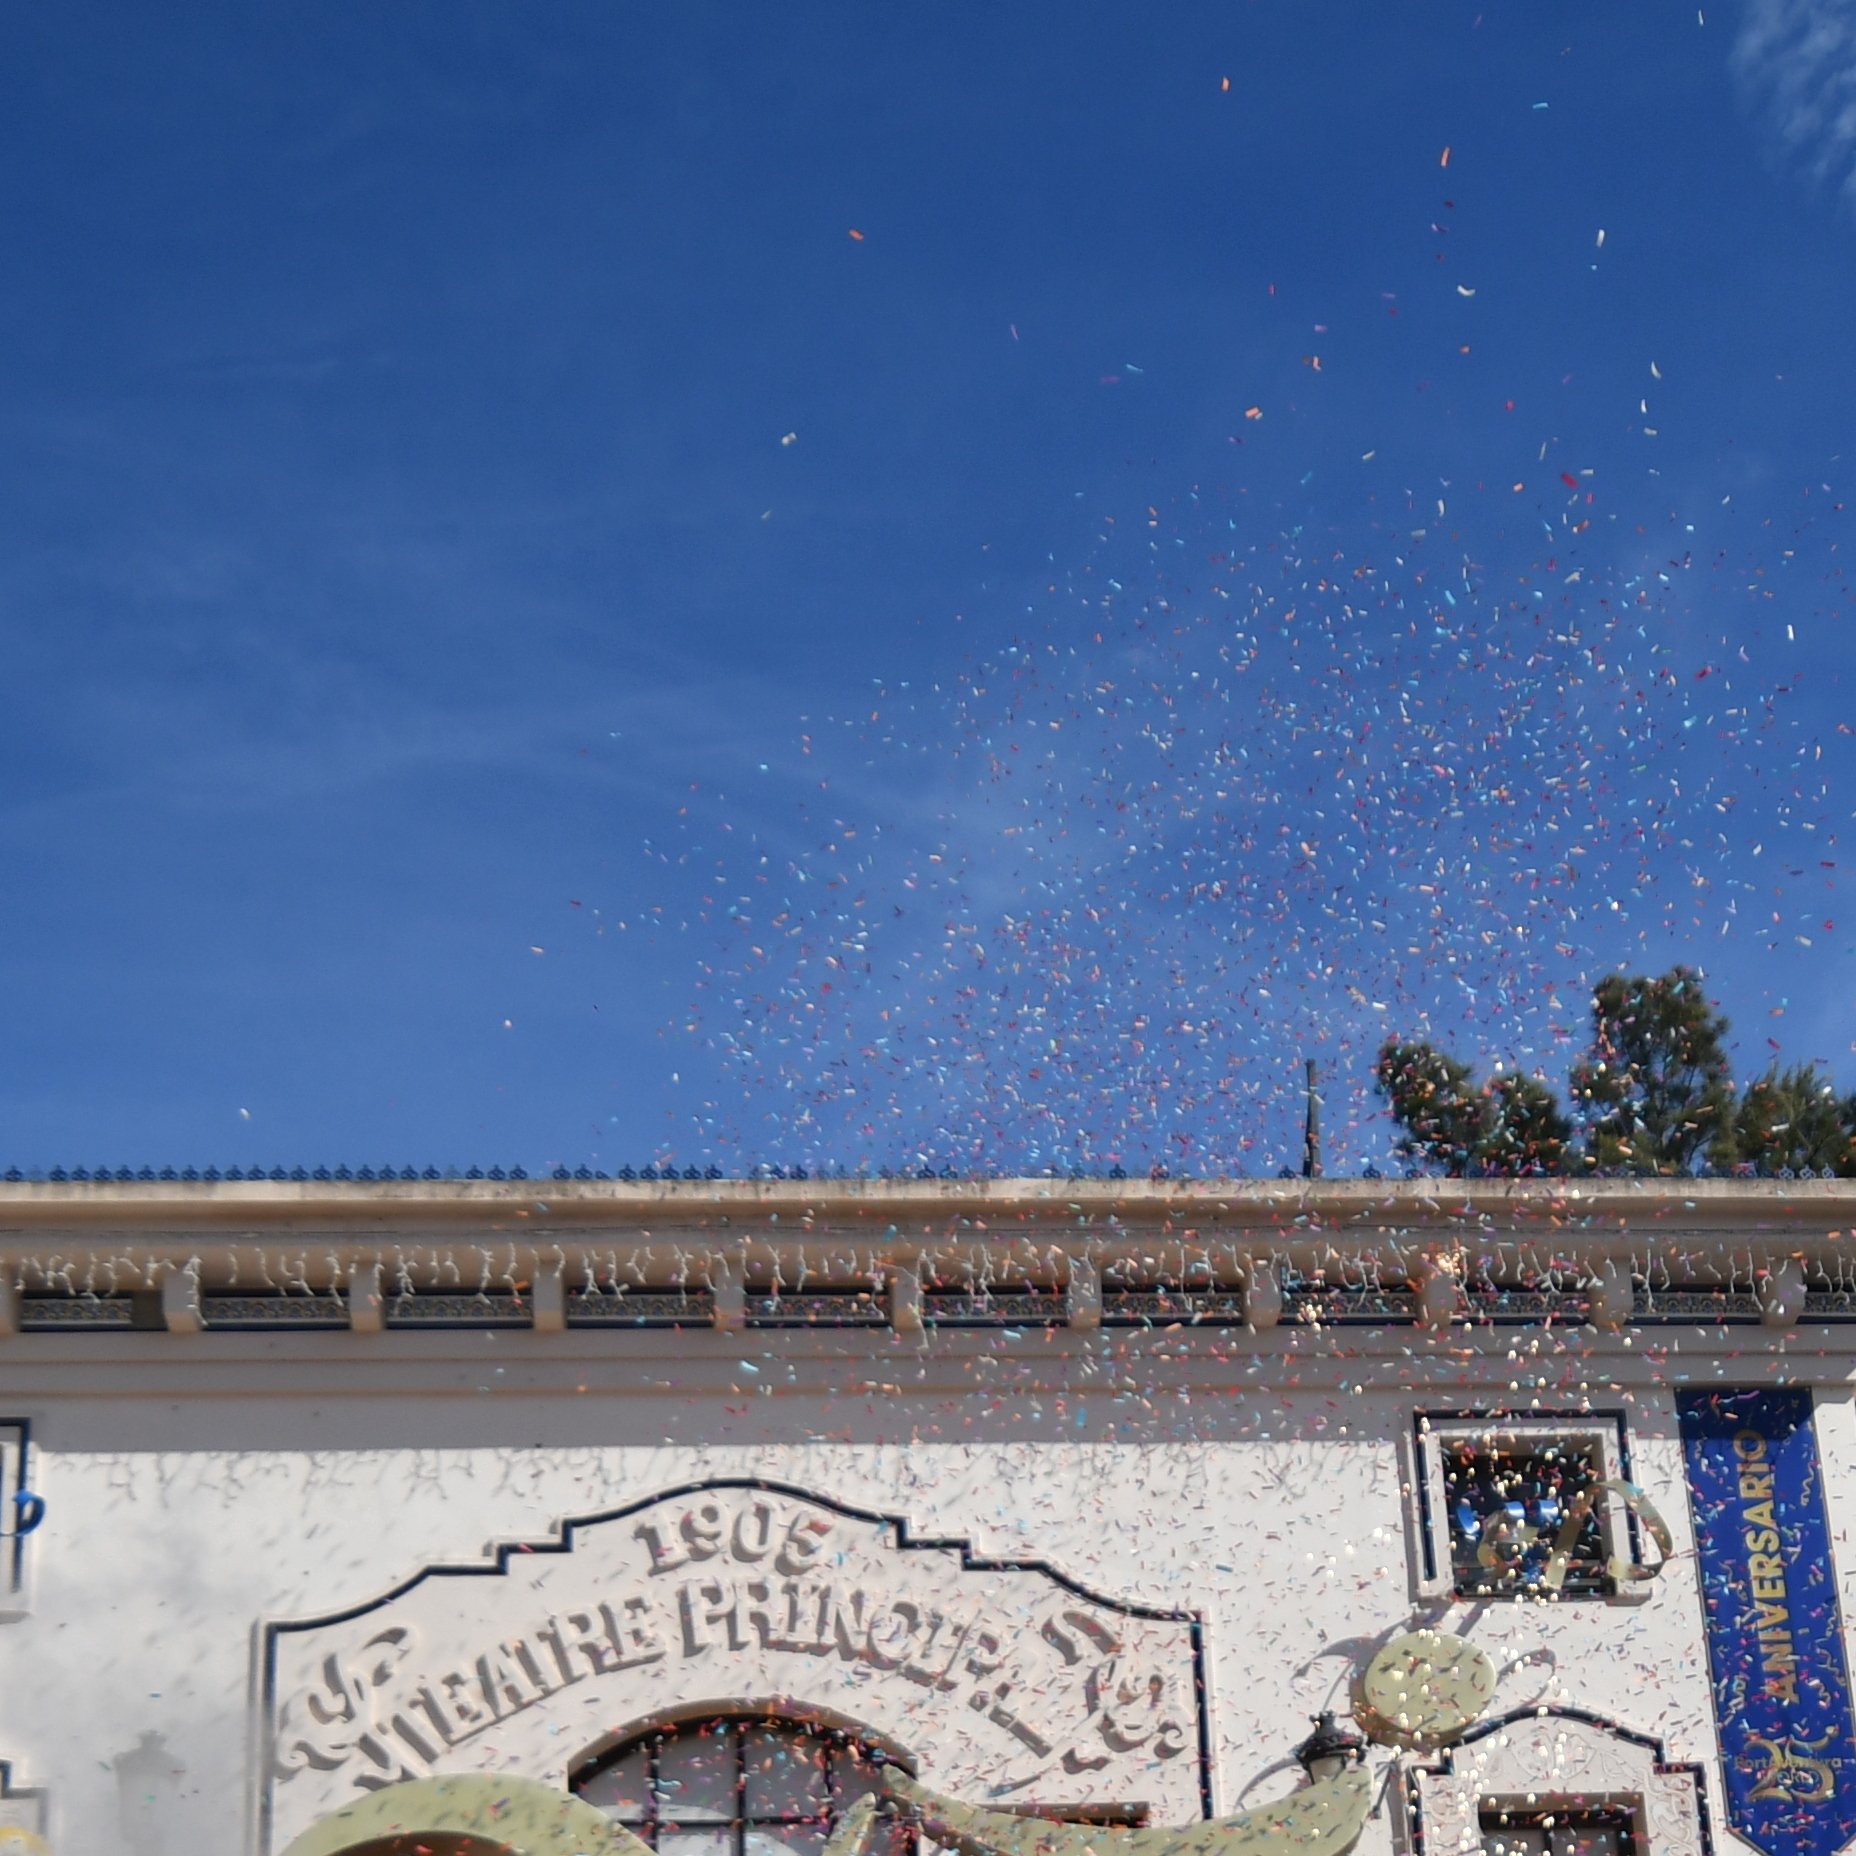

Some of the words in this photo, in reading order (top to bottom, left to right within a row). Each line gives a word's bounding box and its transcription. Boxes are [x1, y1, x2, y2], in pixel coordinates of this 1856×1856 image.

[633, 1500, 835, 1577] 1905
[1733, 1429, 1800, 1704] ANIVERSARIO
[676, 1580, 1054, 1762] PRINCIPAL
